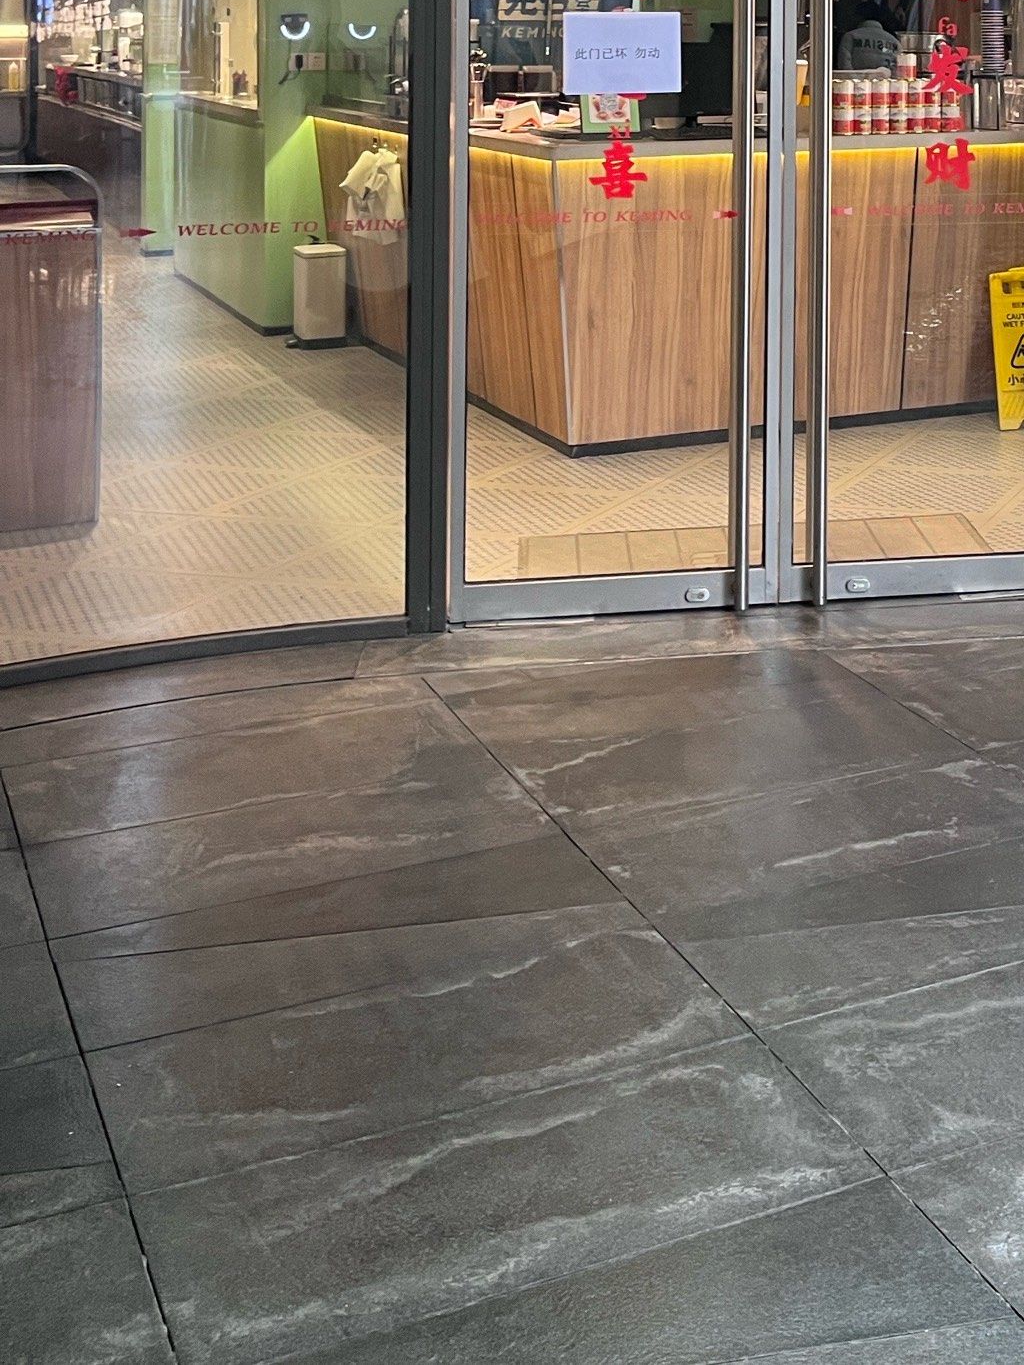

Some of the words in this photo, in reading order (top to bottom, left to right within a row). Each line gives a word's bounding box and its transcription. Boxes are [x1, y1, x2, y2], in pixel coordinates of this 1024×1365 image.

[938, 17, 958, 37] fa
[574, 47, 628, 60] 此门已坏
[634, 46, 661, 59] 勿动
[582, 209, 607, 223] TO
[177, 221, 282, 237] WELCOME
[292, 220, 319, 233] TO
